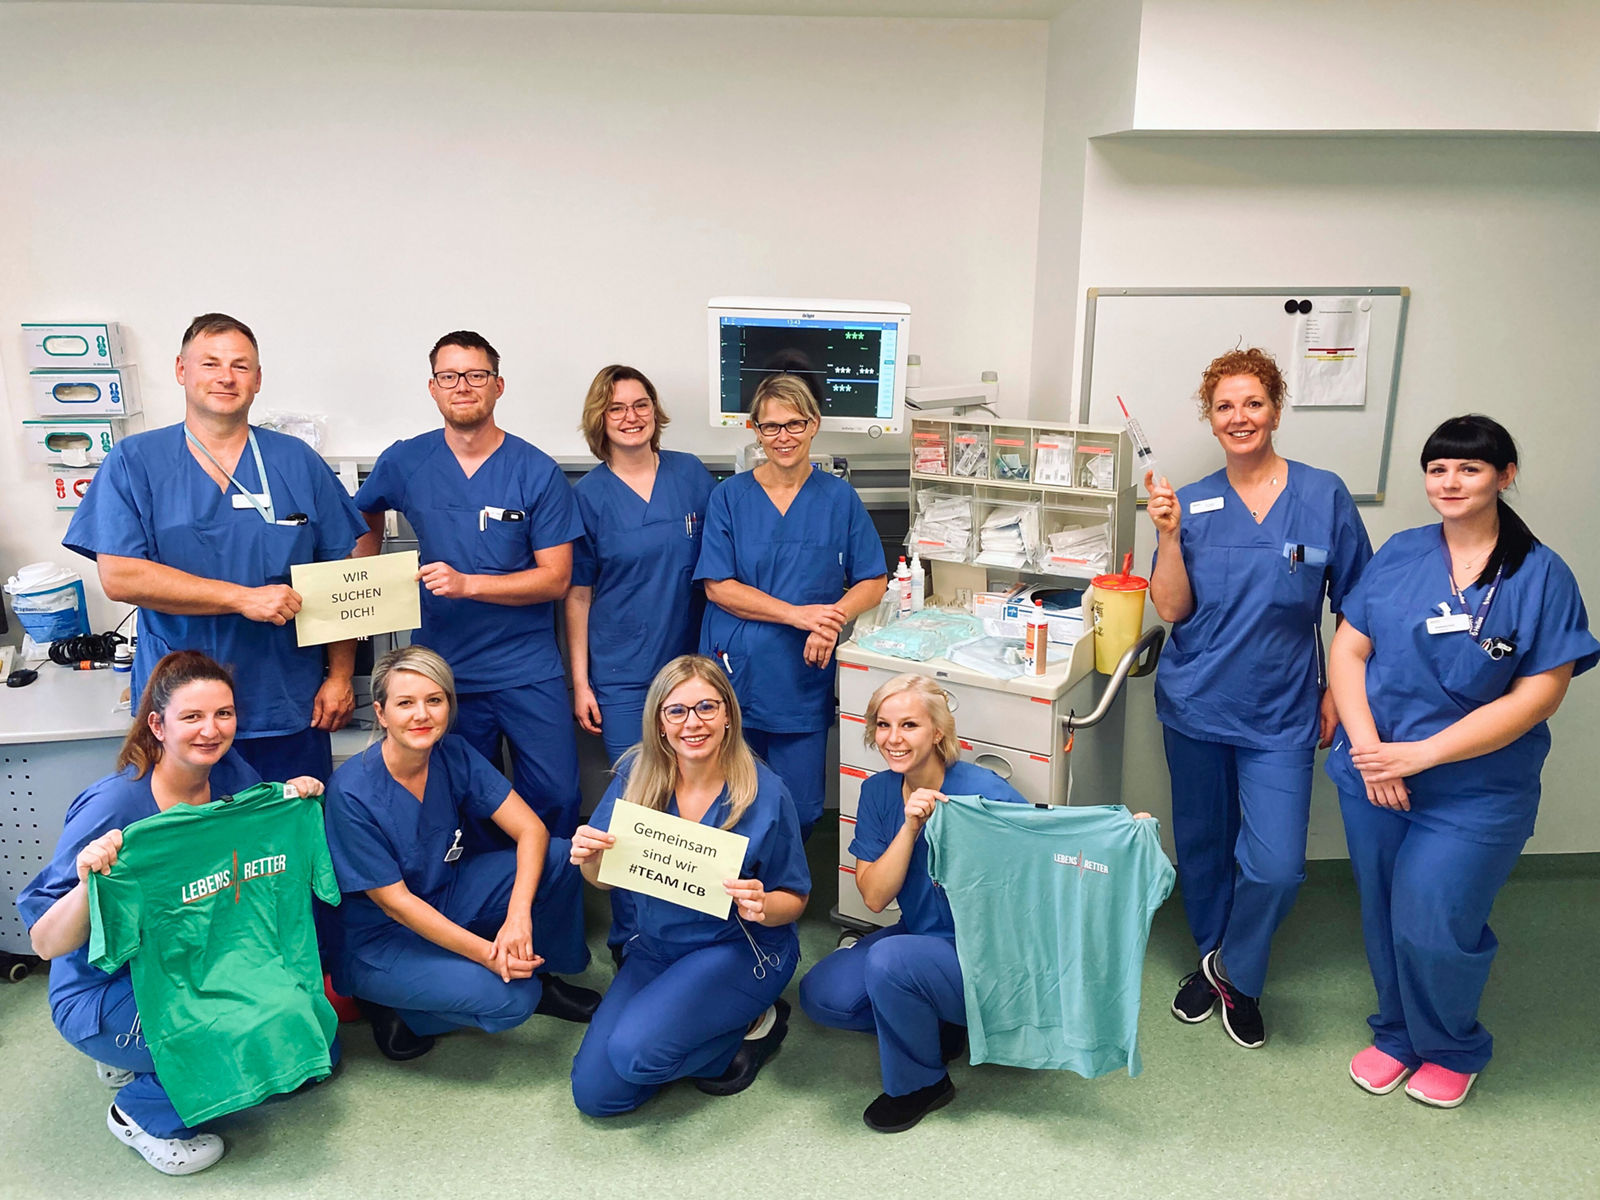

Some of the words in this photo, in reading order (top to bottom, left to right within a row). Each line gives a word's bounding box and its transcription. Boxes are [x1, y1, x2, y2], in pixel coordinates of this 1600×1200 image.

[343, 571, 368, 583] WIR
[331, 587, 381, 603] SUCHEN
[340, 606, 375, 620] DICH!
[633, 822, 718, 858] Gemeinsam
[642, 849, 672, 865] sind
[675, 860, 698, 873] wir
[1053, 853, 1078, 866] LEBENS
[1083, 859, 1109, 874] RETTER
[181, 869, 230, 903] LEBENS
[244, 854, 286, 880] RETTER
[629, 864, 679, 888] #TEAM
[682, 882, 706, 897] ICB
